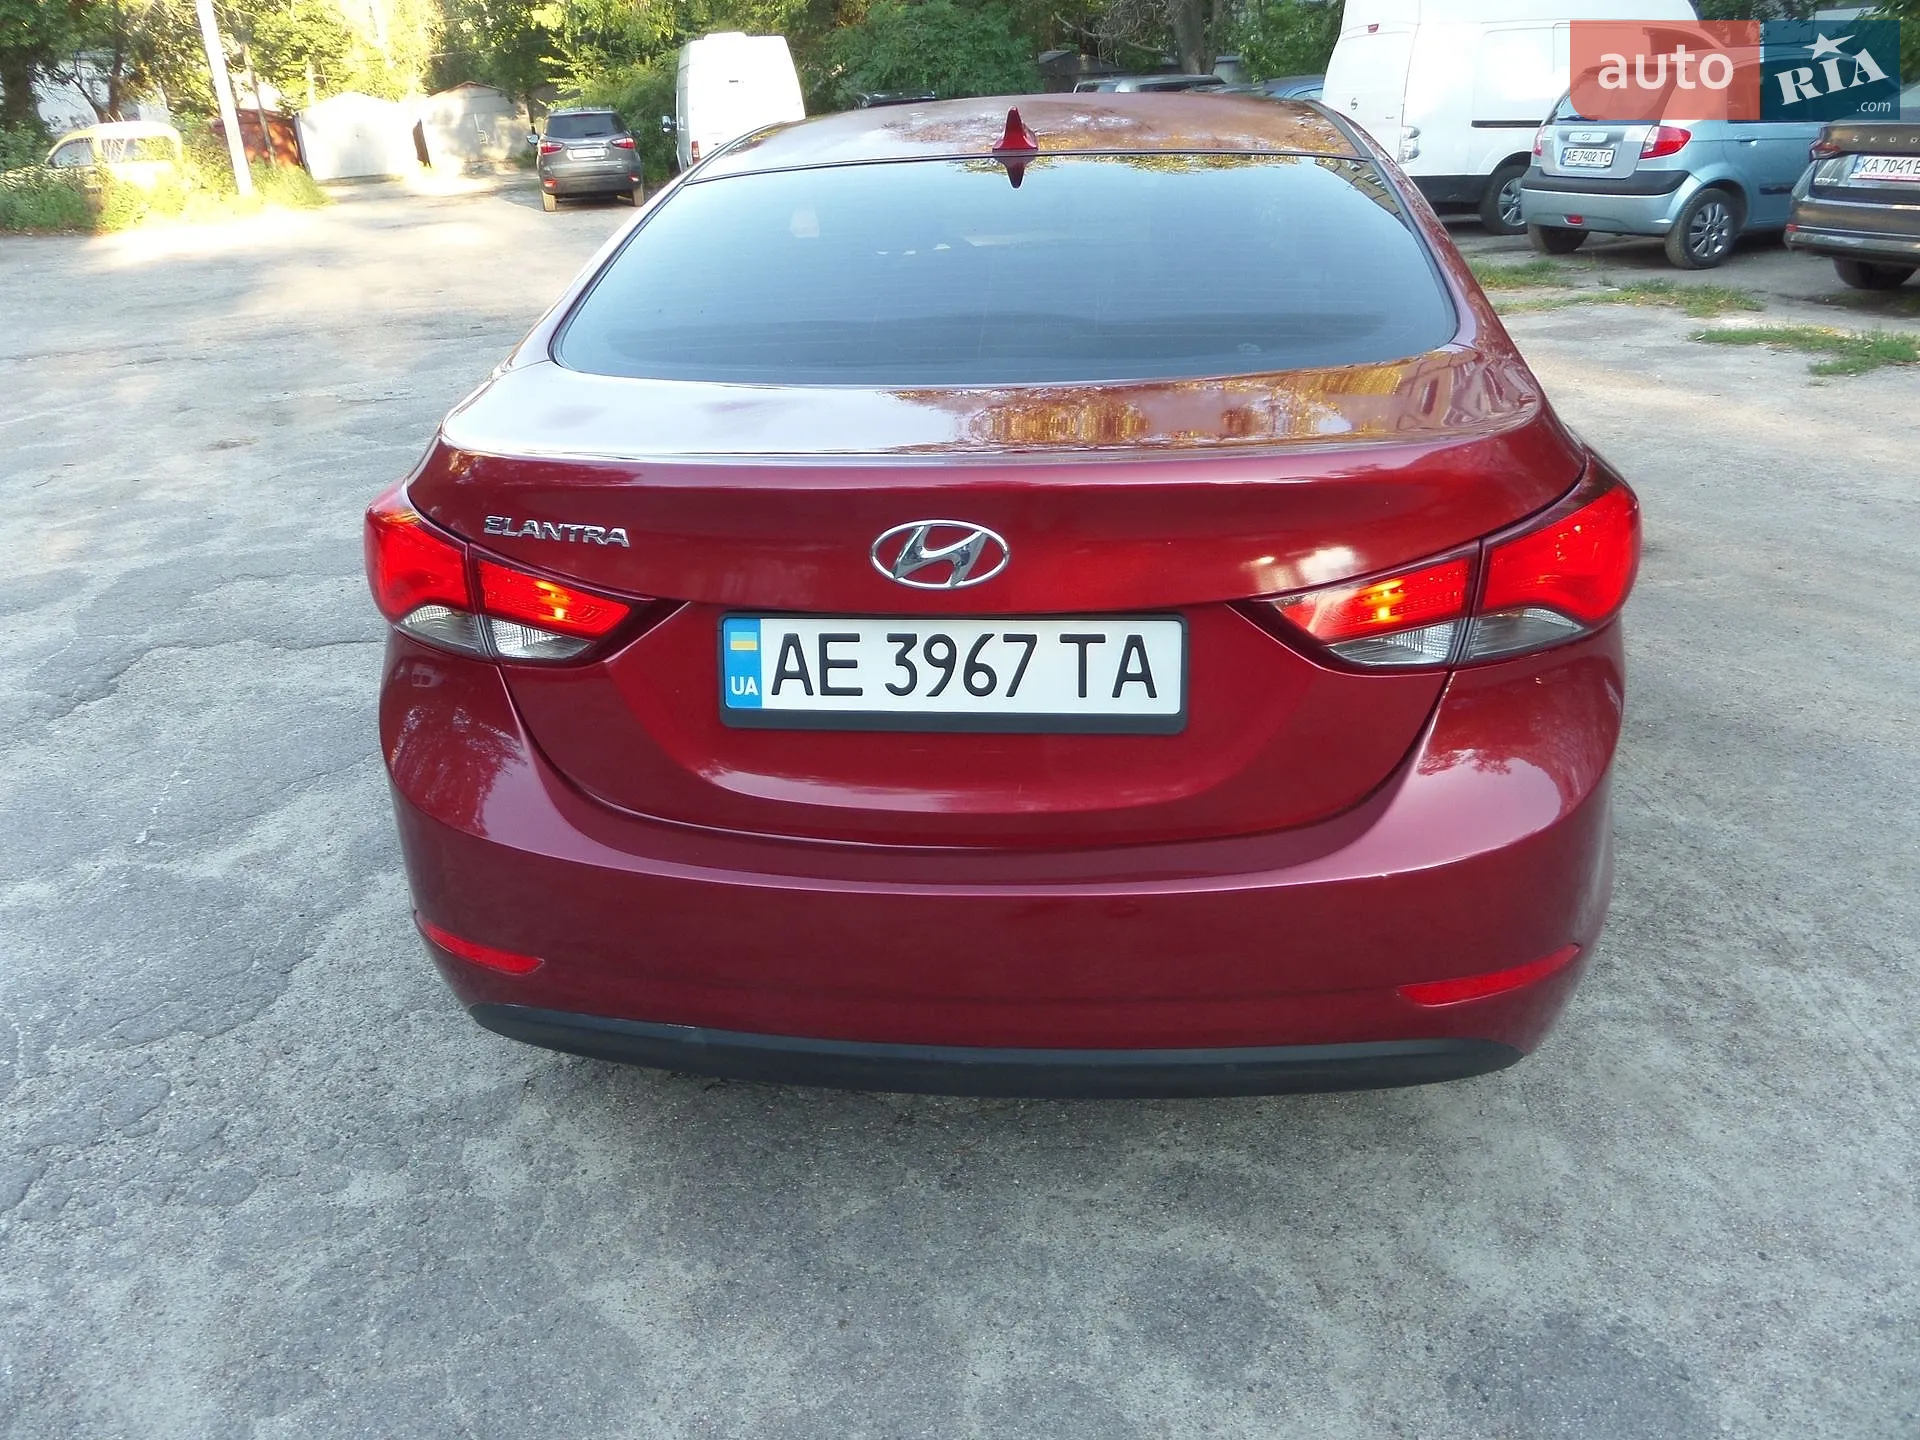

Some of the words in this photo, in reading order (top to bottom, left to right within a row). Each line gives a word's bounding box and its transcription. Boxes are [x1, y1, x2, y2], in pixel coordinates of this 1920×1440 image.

[1567, 150, 1578, 161] AE
[1599, 151, 1612, 162] TC
[1862, 158, 1879, 172] KA
[1881, 159, 1912, 173] 7041
[484, 515, 631, 548] ELANTRA
[771, 632, 864, 697] AE
[884, 633, 1038, 698] 3967
[1059, 633, 1158, 699] TA
[730, 675, 759, 696] UA
